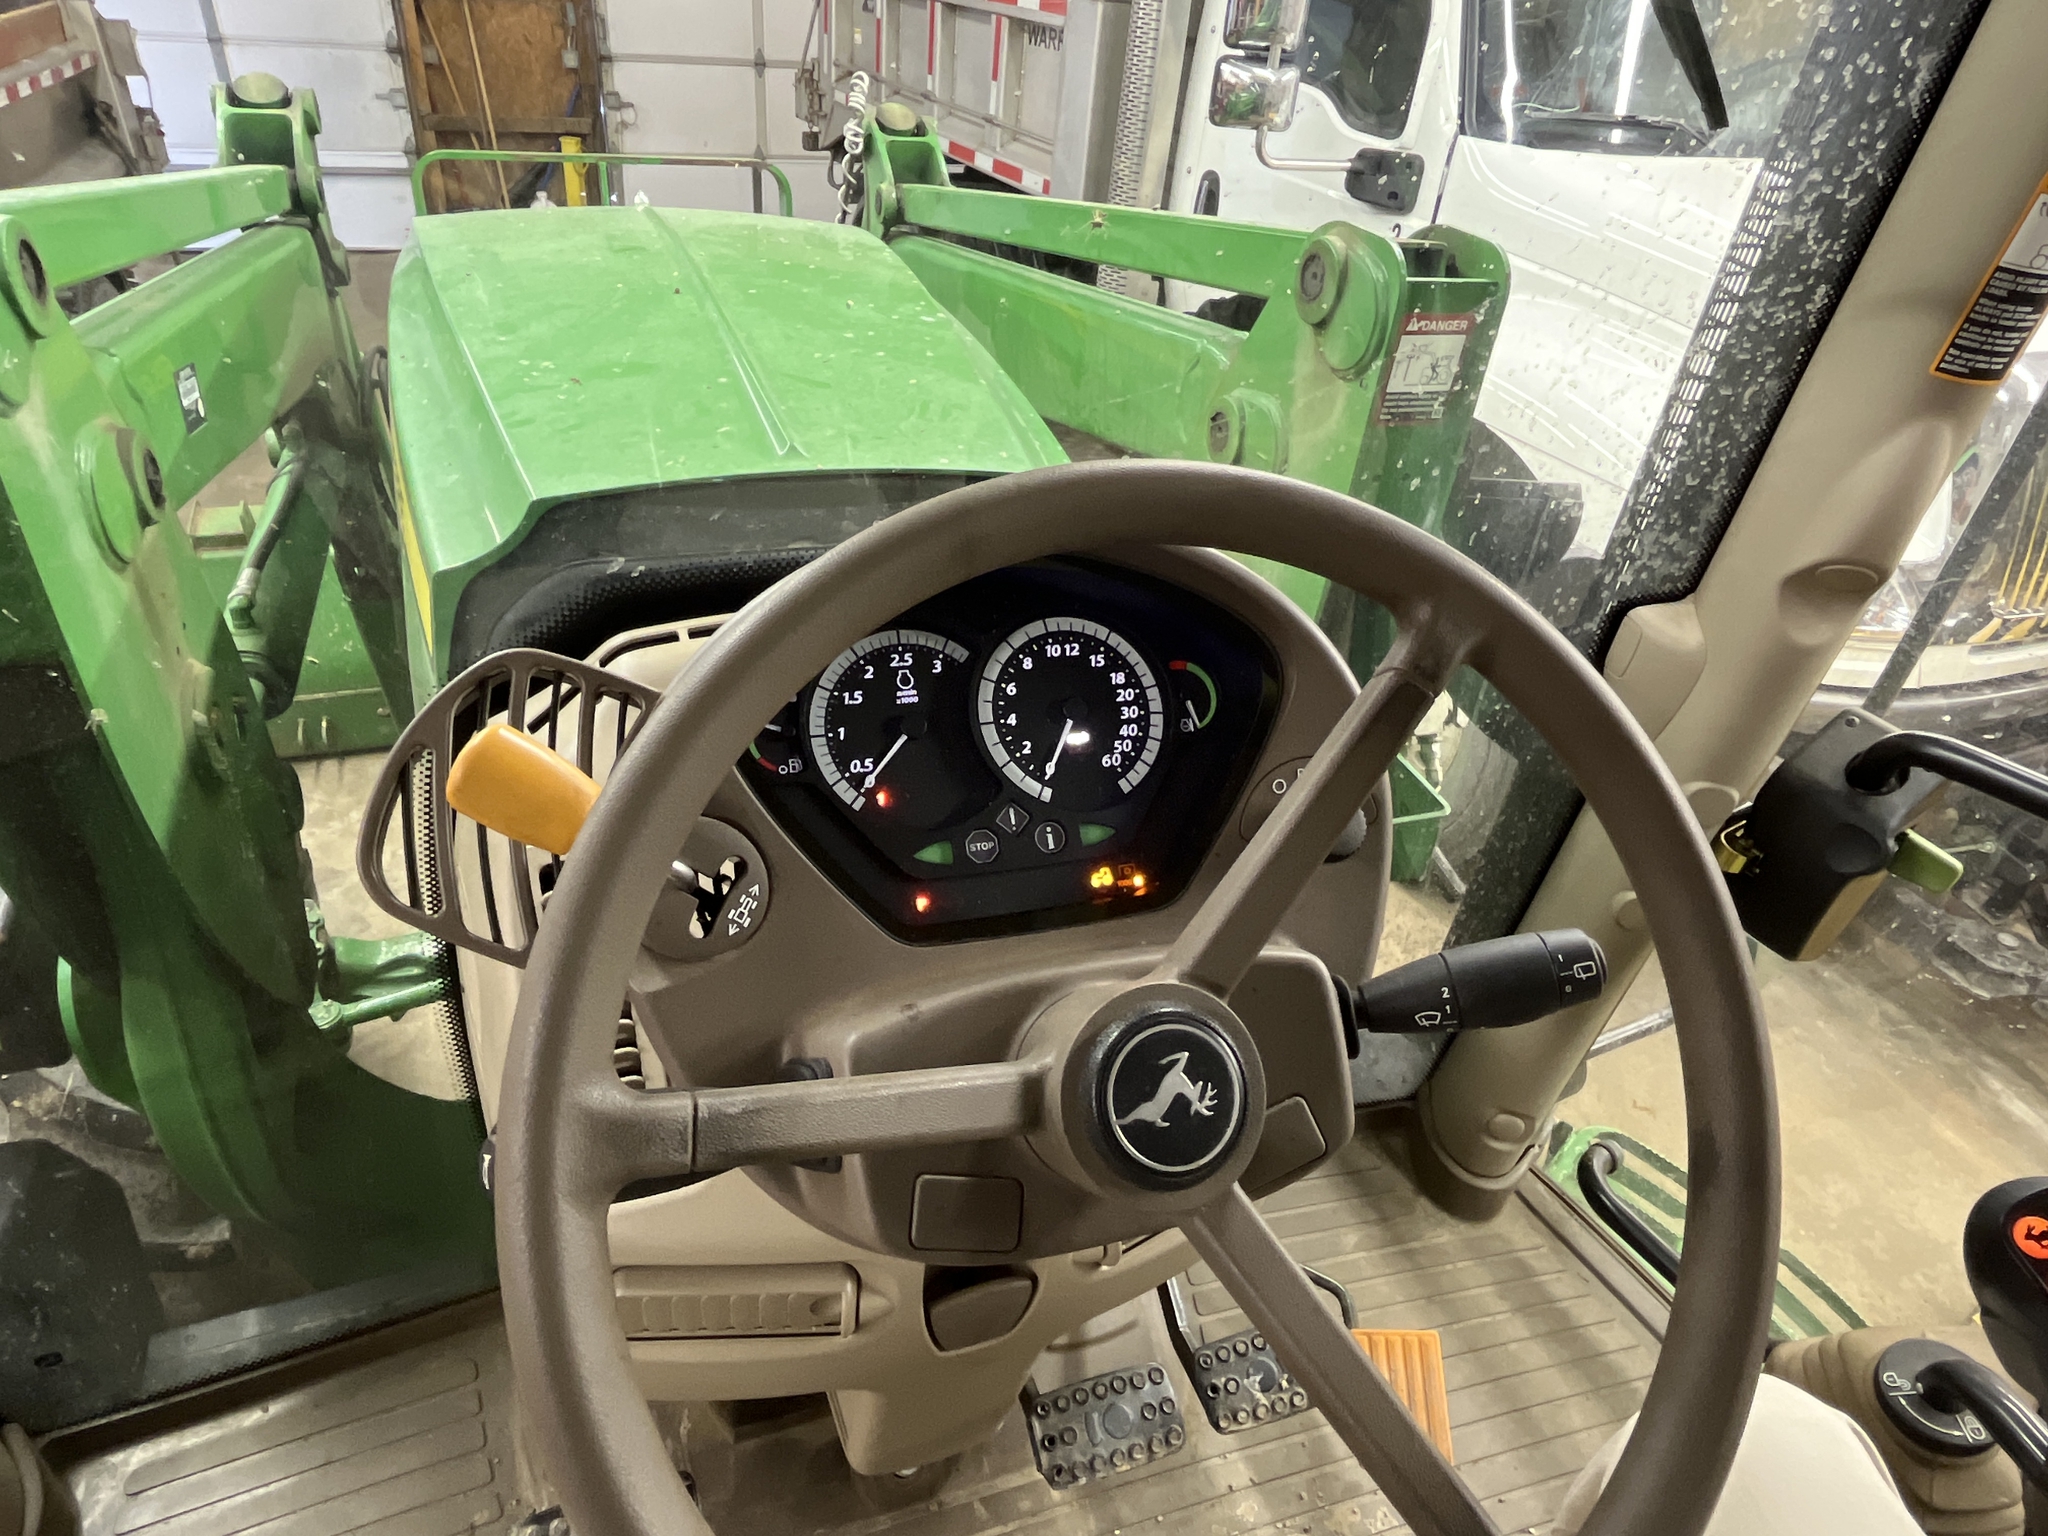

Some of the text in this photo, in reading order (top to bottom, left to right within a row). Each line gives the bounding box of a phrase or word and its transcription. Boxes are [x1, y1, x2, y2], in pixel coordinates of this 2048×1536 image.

[1421, 320, 1468, 331] DANGER
[1045, 644, 1061, 658] 10
[1064, 643, 1080, 657] 12
[890, 653, 913, 667] 2.5
[932, 660, 942, 673] 3
[1022, 657, 1033, 670] 8
[1089, 654, 1105, 668] 15
[864, 666, 874, 679] 2
[1109, 672, 1126, 685] 18
[1006, 682, 1017, 696] 6
[1116, 688, 1134, 702] 20
[842, 690, 863, 705] 1.5
[1120, 705, 1139, 719] 30
[1006, 713, 1017, 727] 4
[837, 727, 845, 741] 1
[1119, 724, 1138, 737] 40
[1021, 741, 1032, 755] 2
[1113, 739, 1132, 753] 50
[850, 758, 874, 773] 0.5
[1101, 753, 1121, 768] 60
[969, 841, 994, 852] STOP
[1558, 954, 1564, 963] 1
[1441, 986, 1451, 998] 2
[1445, 1004, 1451, 1014] 1
